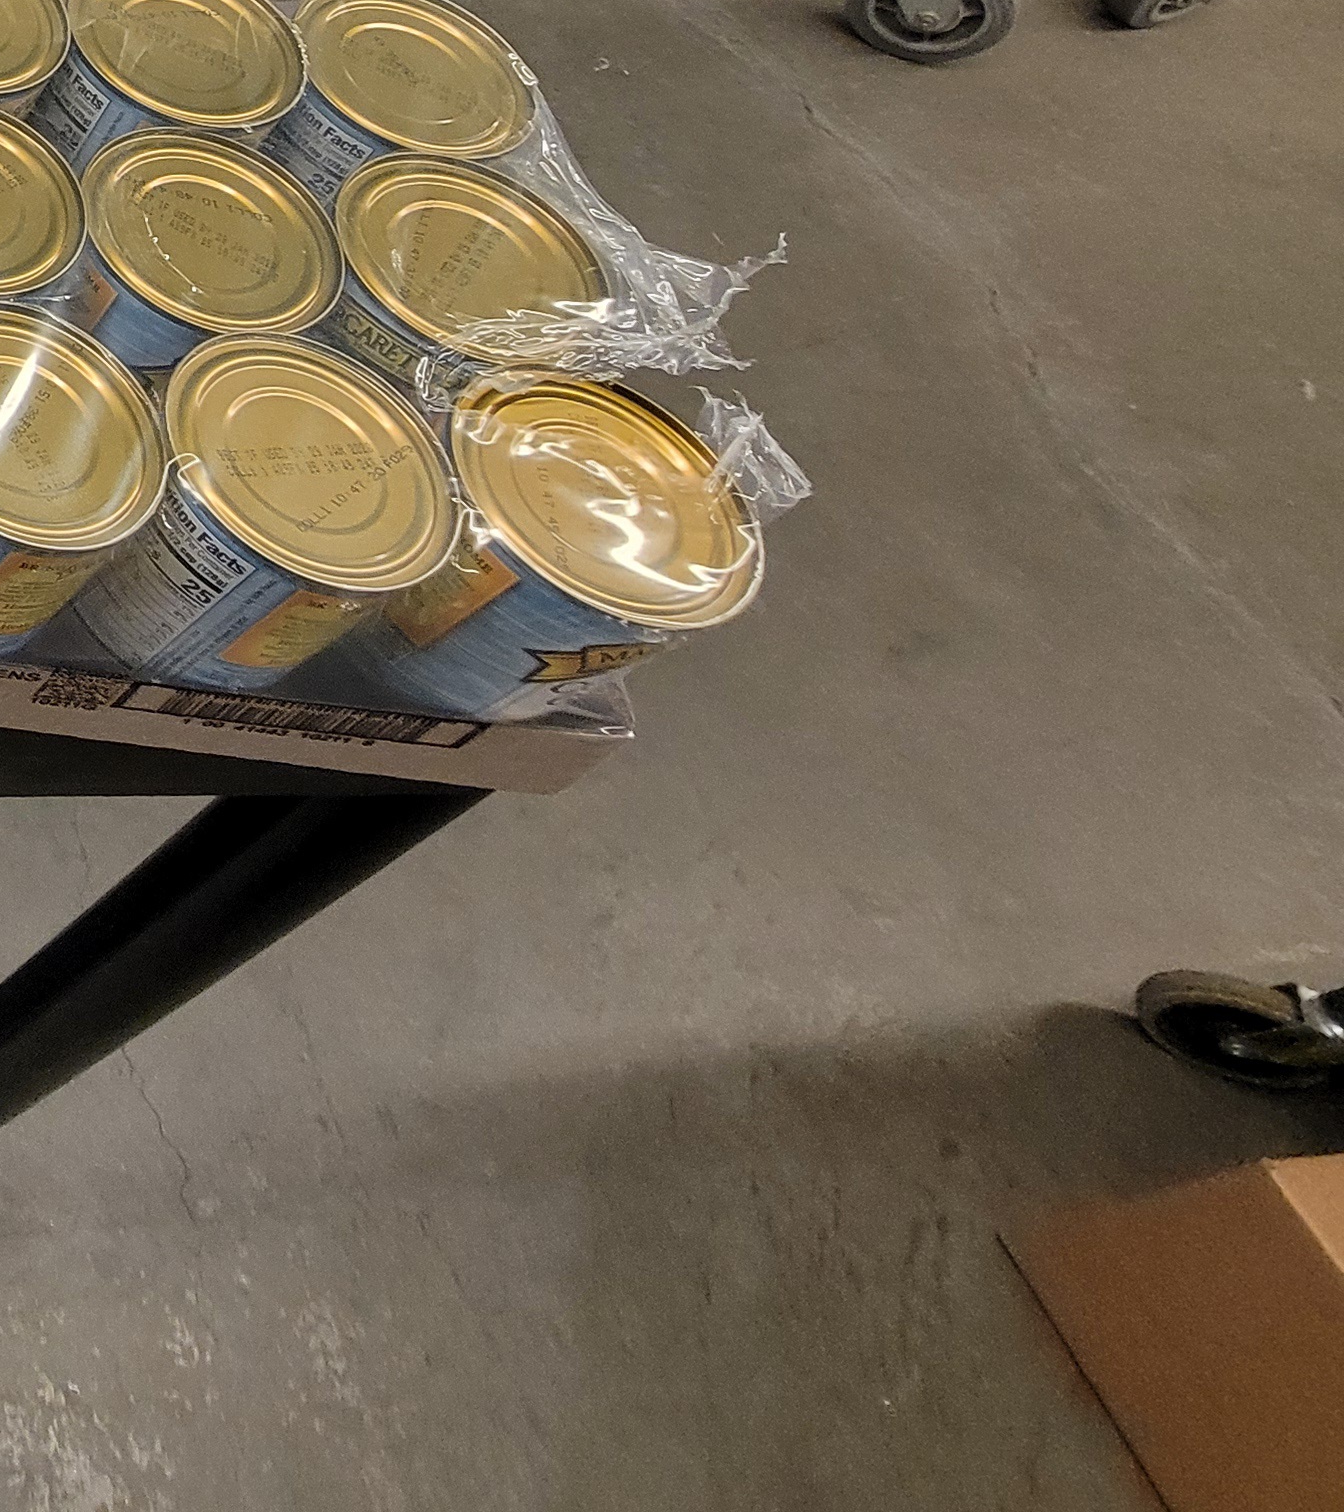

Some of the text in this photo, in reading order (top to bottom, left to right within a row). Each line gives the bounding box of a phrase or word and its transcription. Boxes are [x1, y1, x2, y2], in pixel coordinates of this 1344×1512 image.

[72, 65, 105, 111] Facts
[323, 125, 366, 160] Facts
[197, 531, 247, 576] Facts
[179, 578, 212, 605] 25
